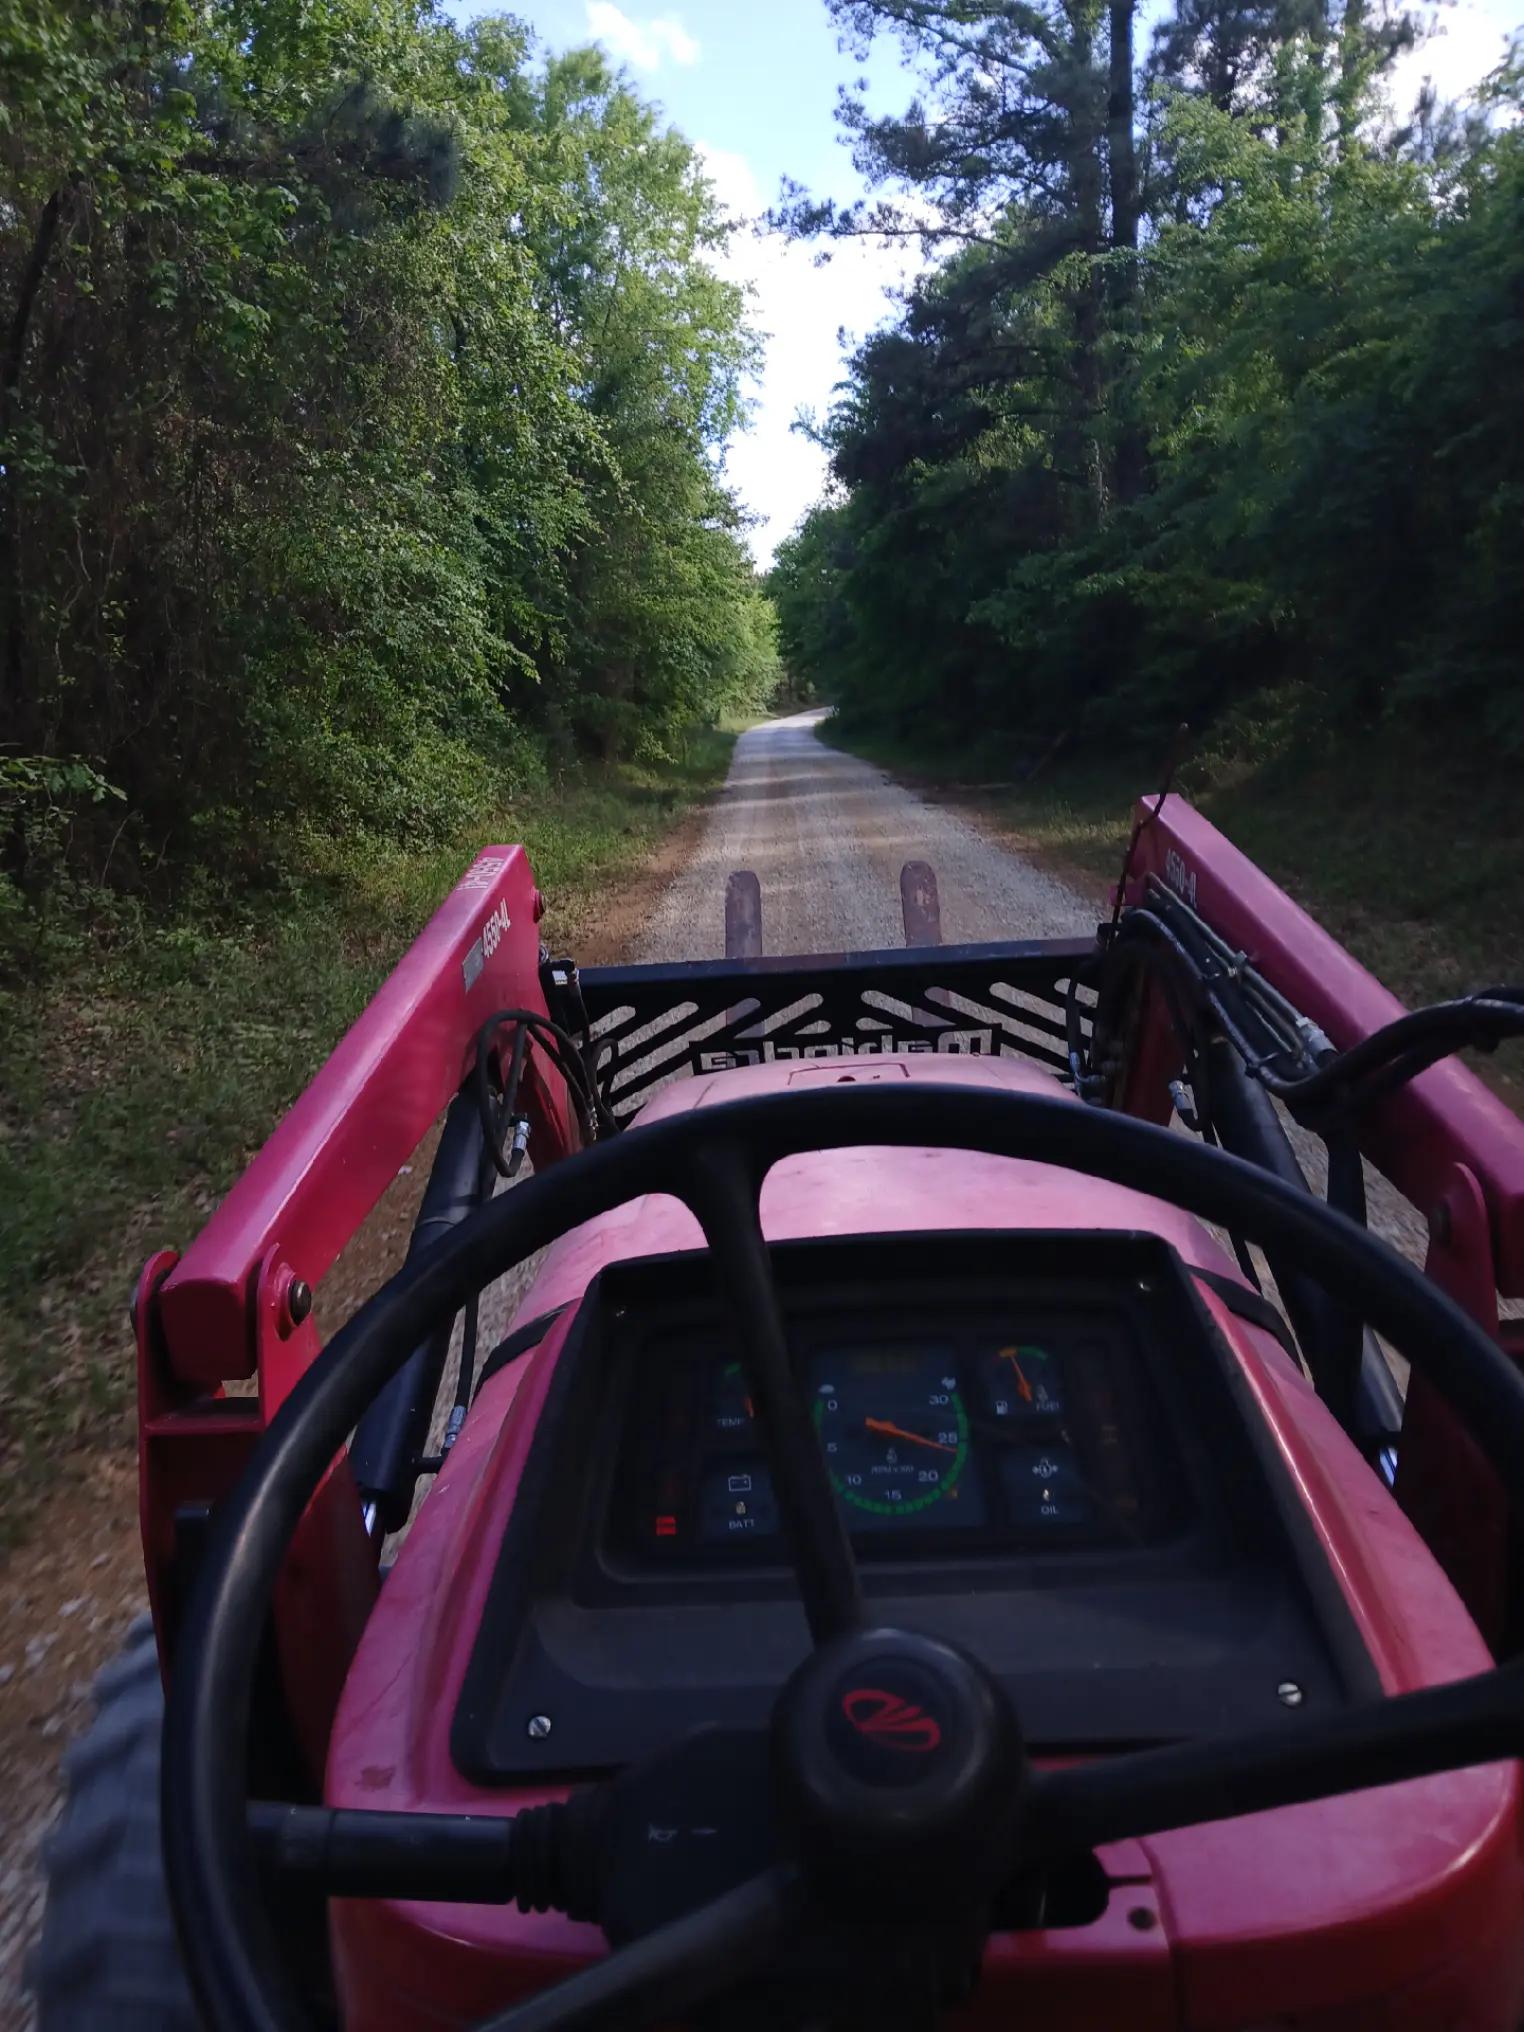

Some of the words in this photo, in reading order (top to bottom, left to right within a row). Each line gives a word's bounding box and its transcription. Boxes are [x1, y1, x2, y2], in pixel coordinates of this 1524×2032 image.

[828, 1400, 838, 1411] 0
[929, 1395, 949, 1406] 30
[938, 1433, 958, 1444] 25
[826, 1442, 838, 1453] 5
[848, 1475, 862, 1485] 10
[918, 1471, 939, 1482] 20
[884, 1489, 902, 1500] 15
[1040, 1505, 1060, 1515] OIL
[729, 1519, 755, 1529] BATT
